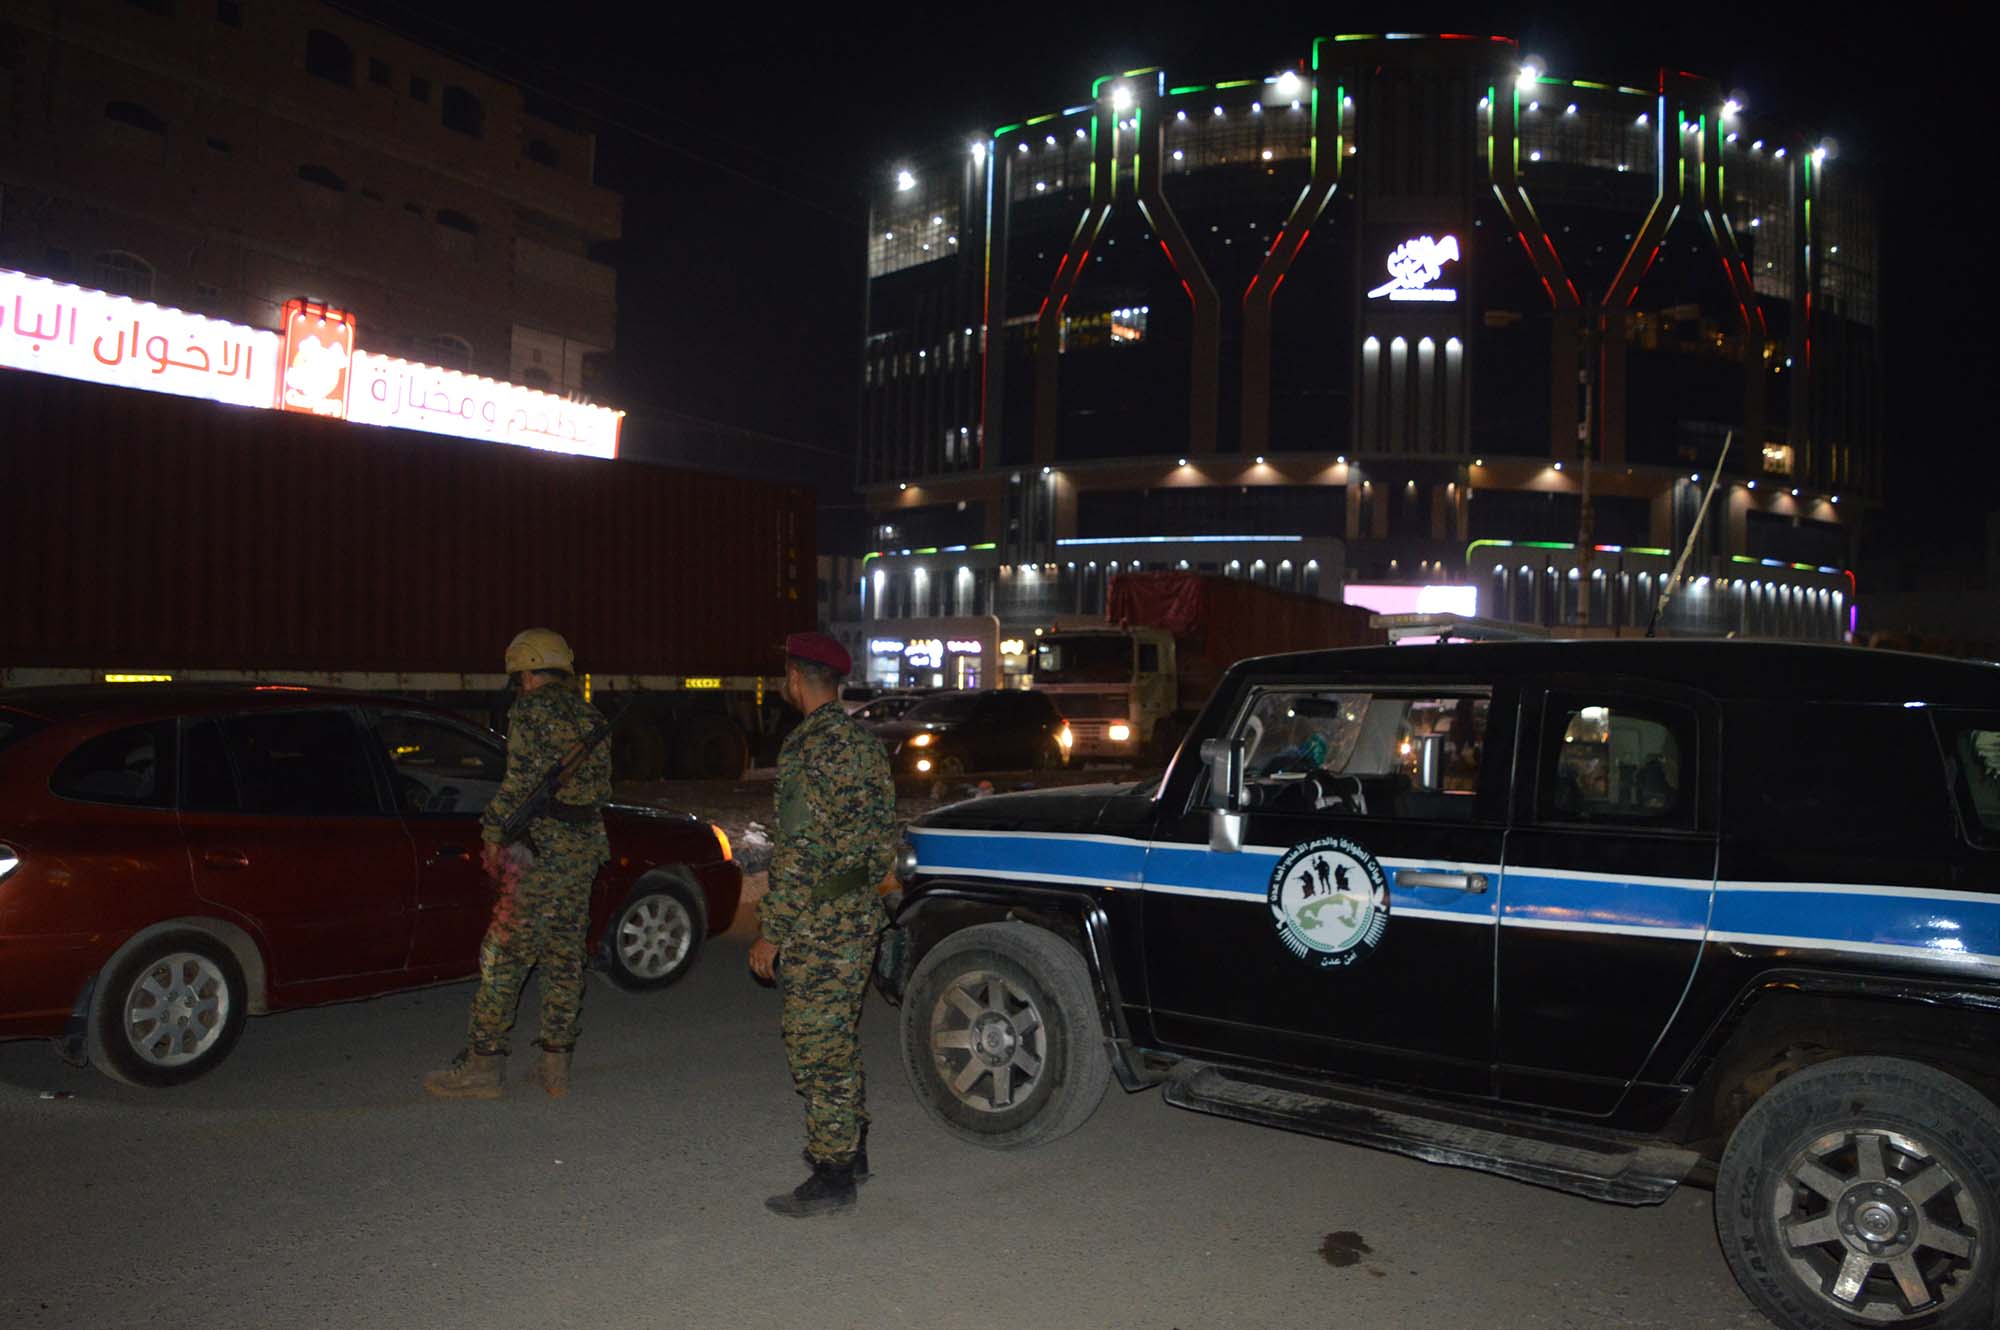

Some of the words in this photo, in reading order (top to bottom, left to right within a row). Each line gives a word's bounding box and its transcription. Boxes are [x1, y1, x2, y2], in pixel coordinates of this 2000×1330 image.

[93, 315, 252, 379] الاخوان
[371, 367, 497, 432] ومخبازة
[1310, 836, 1338, 850] والدعم
[1367, 860, 1384, 884] قوات
[1320, 957, 1342, 967] عدن
